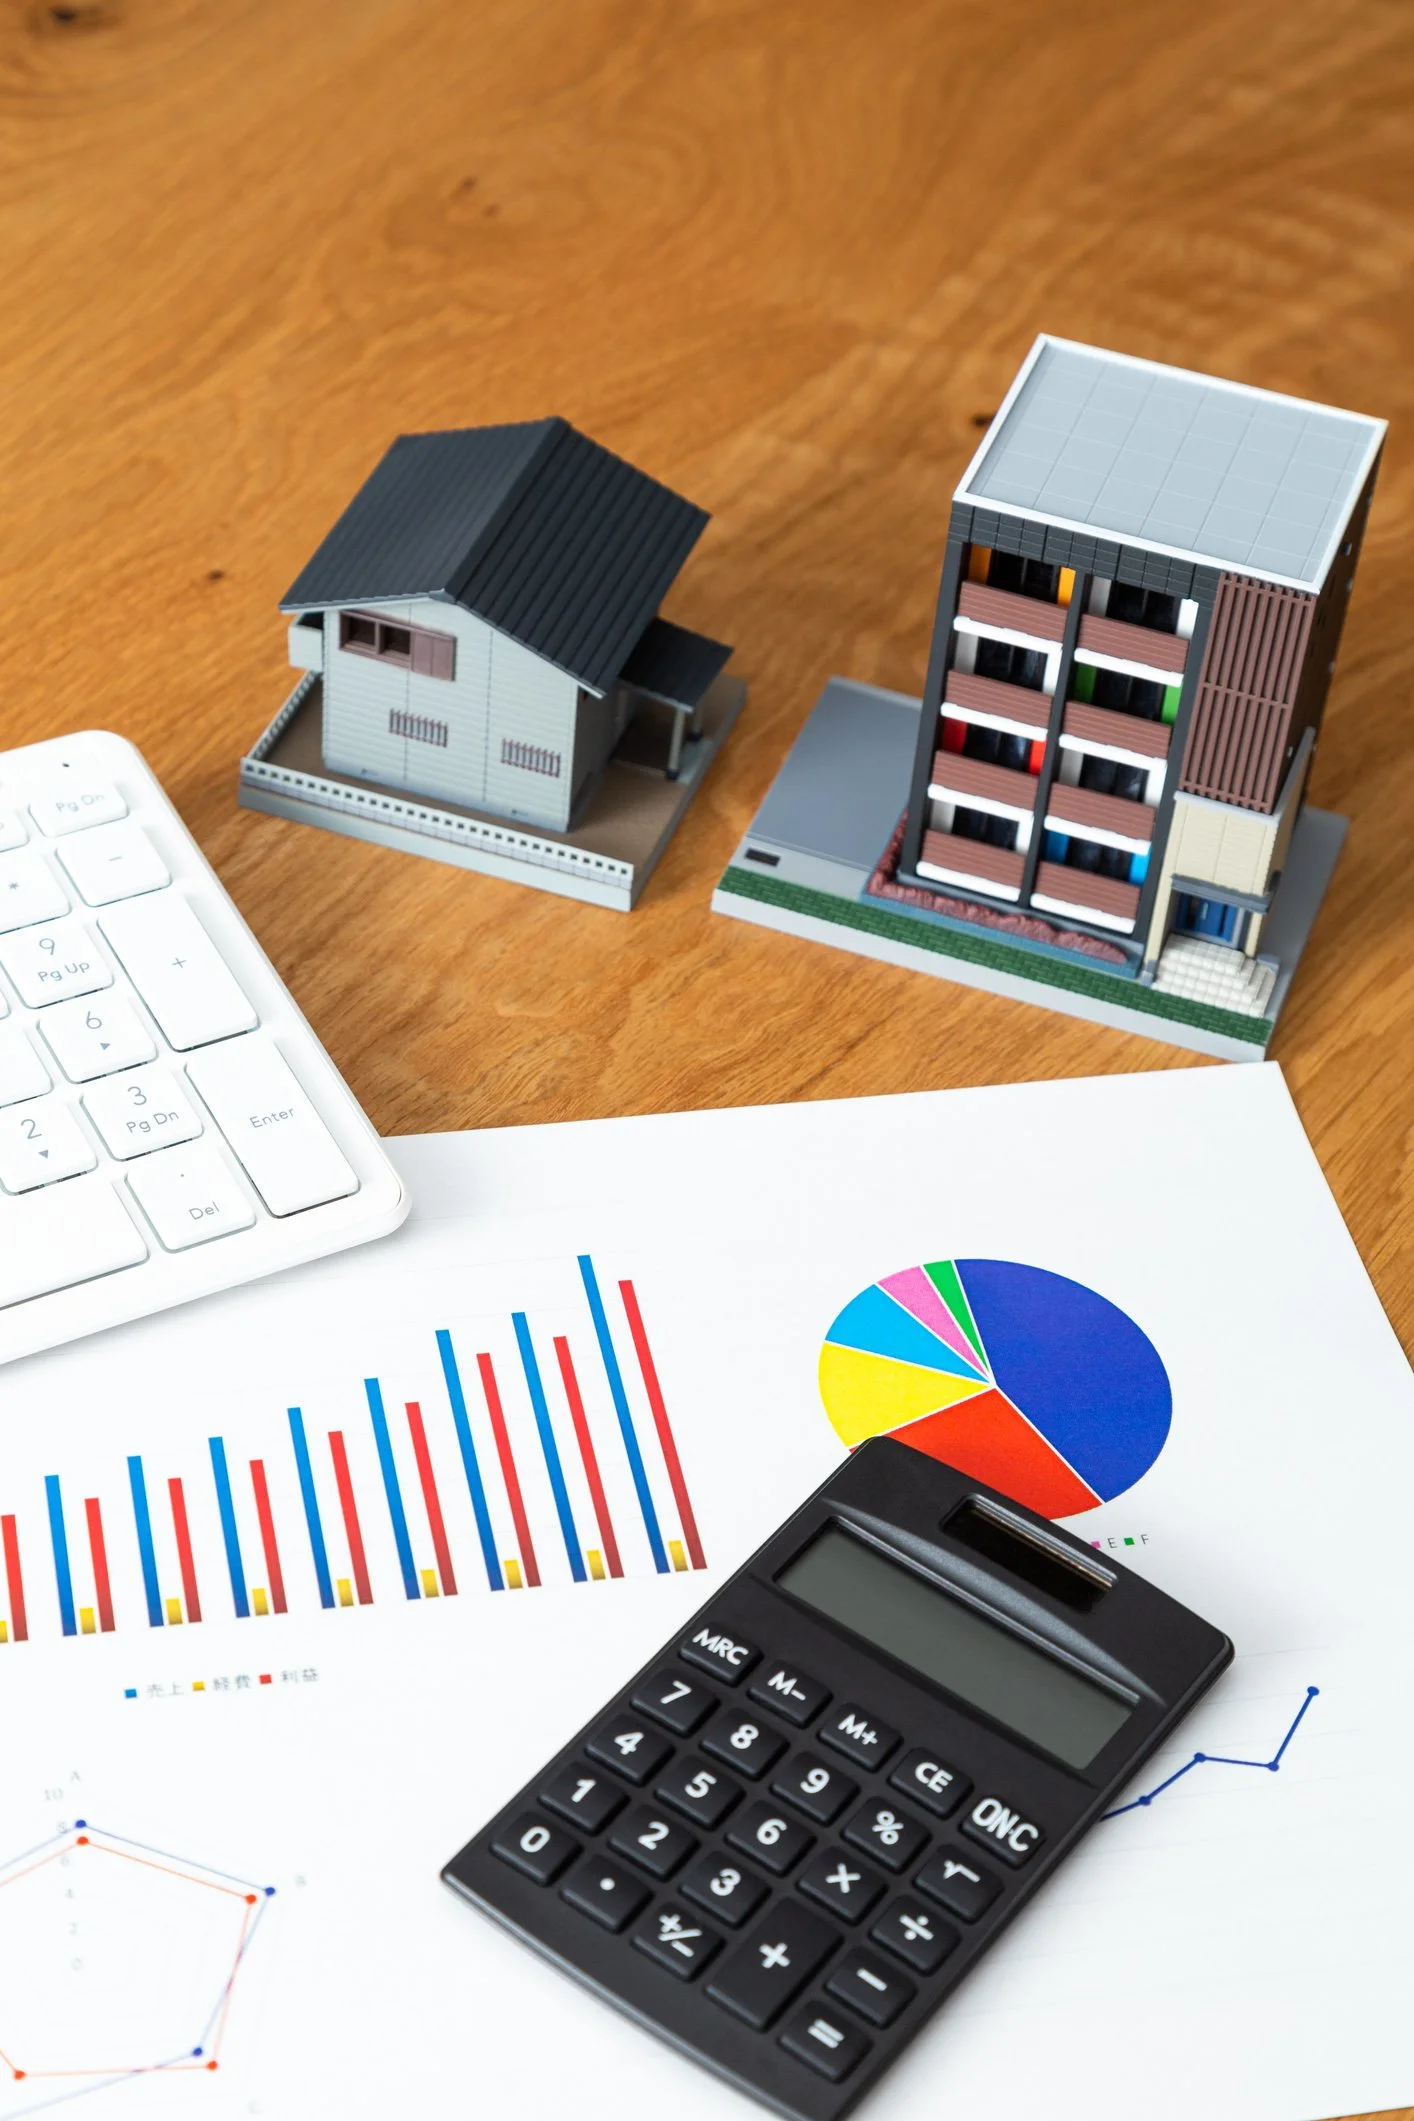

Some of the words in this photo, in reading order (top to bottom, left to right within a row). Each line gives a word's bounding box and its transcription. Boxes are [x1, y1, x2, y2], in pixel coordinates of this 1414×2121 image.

[55, 801, 79, 813] Pg
[80, 794, 105, 806] Dn
[38, 937, 56, 956] 9
[37, 970, 63, 982] Pg
[64, 962, 90, 974] Up
[85, 1010, 103, 1030] 6
[127, 1085, 148, 1106] 3
[20, 1118, 43, 1140] 2
[125, 1120, 151, 1134] Pg
[152, 1111, 179, 1126] Dn
[249, 1108, 294, 1129] Enter
[188, 1201, 220, 1221] Del
[1107, 1537, 1118, 1549] E
[1140, 1533, 1149, 1545] F
[692, 1628, 749, 1666] MRC
[660, 1680, 692, 1705] 7
[730, 1724, 759, 1750] 8
[837, 1714, 878, 1746] M+
[614, 1731, 644, 1756] 4
[684, 1771, 717, 1799] 5
[800, 1768, 830, 1794] 9
[914, 1762, 953, 1794] CE
[571, 1779, 596, 1803] 1
[519, 1826, 551, 1853] 0
[637, 1821, 669, 1851] 2
[756, 1818, 787, 1846] 6
[871, 1810, 904, 1845] %
[710, 1868, 741, 1897] 3
